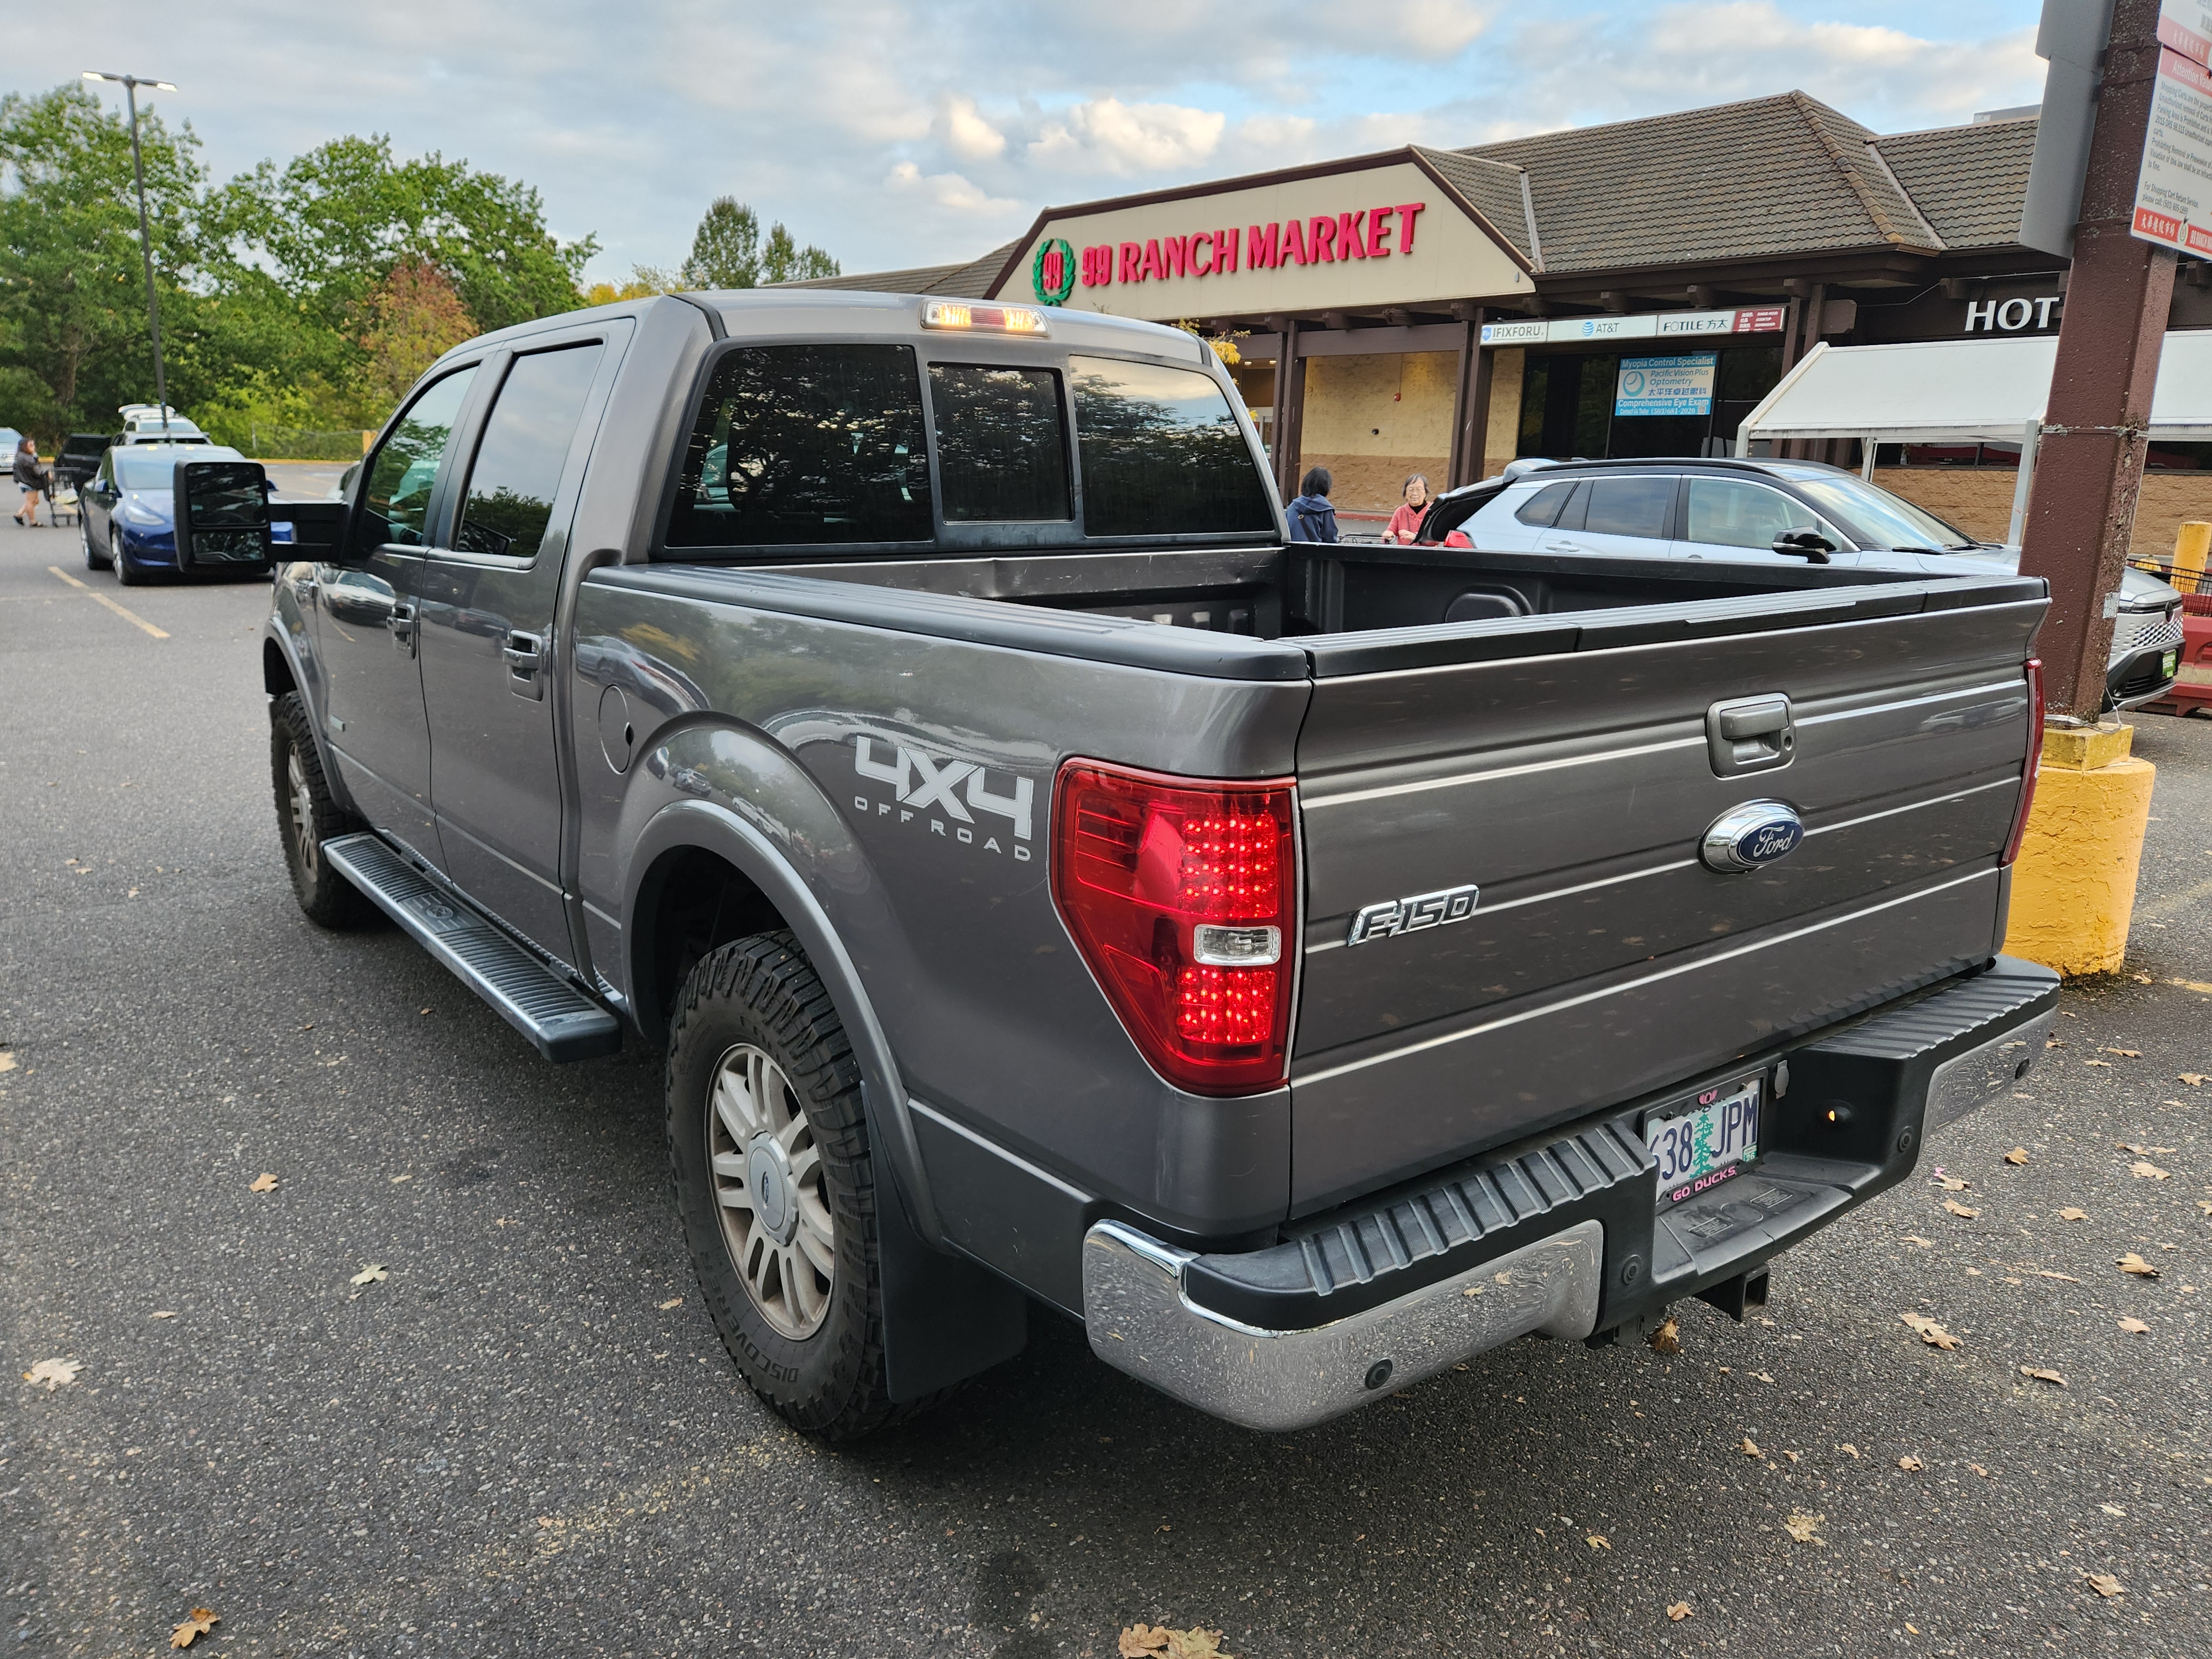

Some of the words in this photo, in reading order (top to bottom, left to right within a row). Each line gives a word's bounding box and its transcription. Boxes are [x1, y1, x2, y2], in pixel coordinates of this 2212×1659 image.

[2173, 60, 2198, 84] Attention
[2161, 81, 2178, 97] Shopping
[2178, 89, 2187, 101] Carts
[2157, 103, 2171, 118] Parking
[2184, 115, 2200, 130] Prohibited
[2159, 92, 2182, 110] Unauthorized
[2200, 111, 2209, 122] Carts
[2156, 115, 2164, 126] 2015
[2150, 149, 2166, 161] Violation
[2152, 137, 2171, 153] Prohibiting
[2172, 145, 2186, 158] Removal
[2142, 193, 2154, 205] please
[2163, 199, 2172, 210] (503)
[2151, 184, 2167, 198] Shopping
[2176, 194, 2187, 204] Return
[1082, 244, 1113, 287] 99
[1118, 228, 1239, 283] RANCH
[1246, 202, 1426, 269] MARKET
[1044, 251, 1063, 289] 99
[1964, 297, 2060, 332] HOT
[1596, 322, 1620, 333] AT&T
[1663, 320, 1704, 331] FOTILE
[1707, 319, 1729, 330] 方太
[1623, 360, 1647, 369] Myopia
[1677, 357, 1713, 367] Specialist
[1648, 388, 1706, 397] 太平洋卓越眼科
[1650, 378, 1693, 387] Optometry
[1618, 398, 1672, 408] Comprehensive
[1674, 399, 1687, 408] Eye
[855, 735, 1034, 841] 4X4
[854, 796, 914, 823] OFF
[931, 819, 1031, 862] ROAD
[1753, 825, 1794, 857] Ford
[1348, 884, 1479, 947] F-150
[1710, 1091, 1758, 1158] JPM
[1746, 1152, 1755, 1162] 26
[1673, 1187, 1690, 1201] GO
